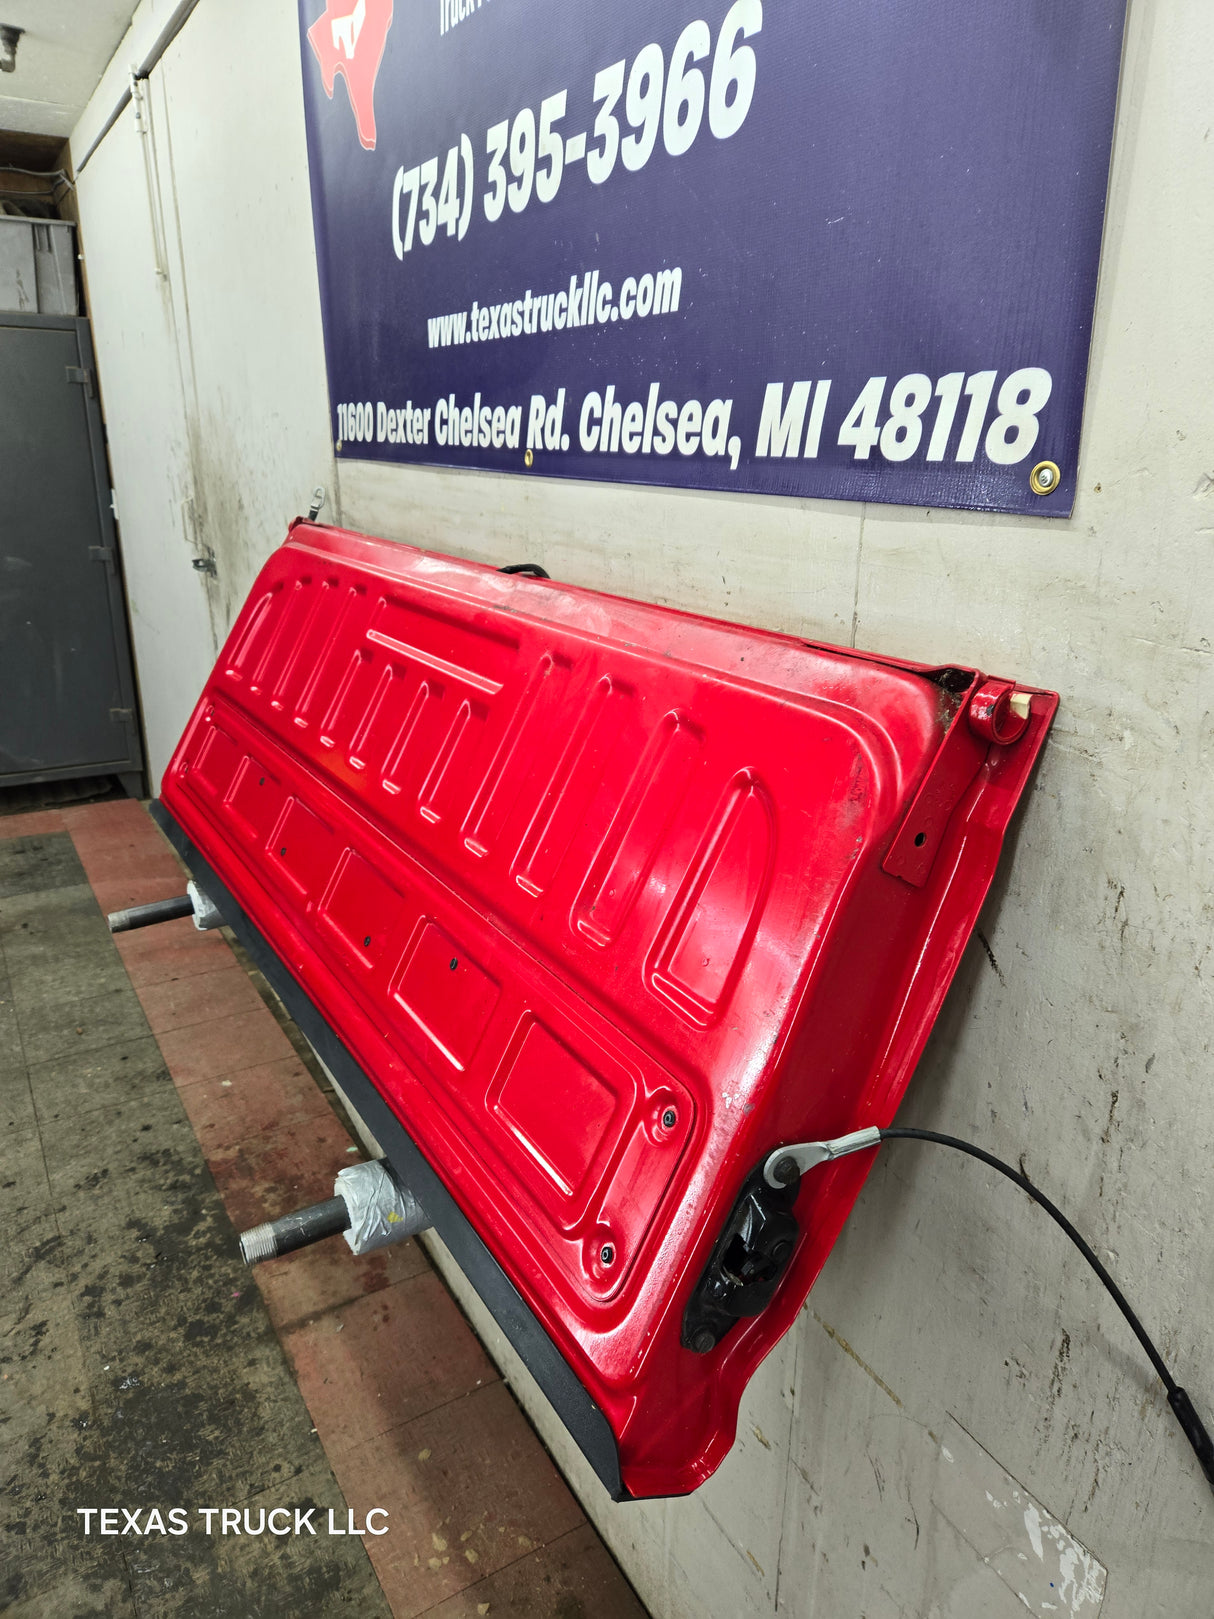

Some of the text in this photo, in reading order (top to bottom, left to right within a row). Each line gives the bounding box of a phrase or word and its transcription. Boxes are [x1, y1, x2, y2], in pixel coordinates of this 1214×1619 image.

[391, 0, 763, 261] (734) 395-3966
[427, 266, 683, 349] www.texastruckllc.com
[336, 367, 1053, 470] 11600 Dexter Chelsea Rd. Chelsea, MI 48118
